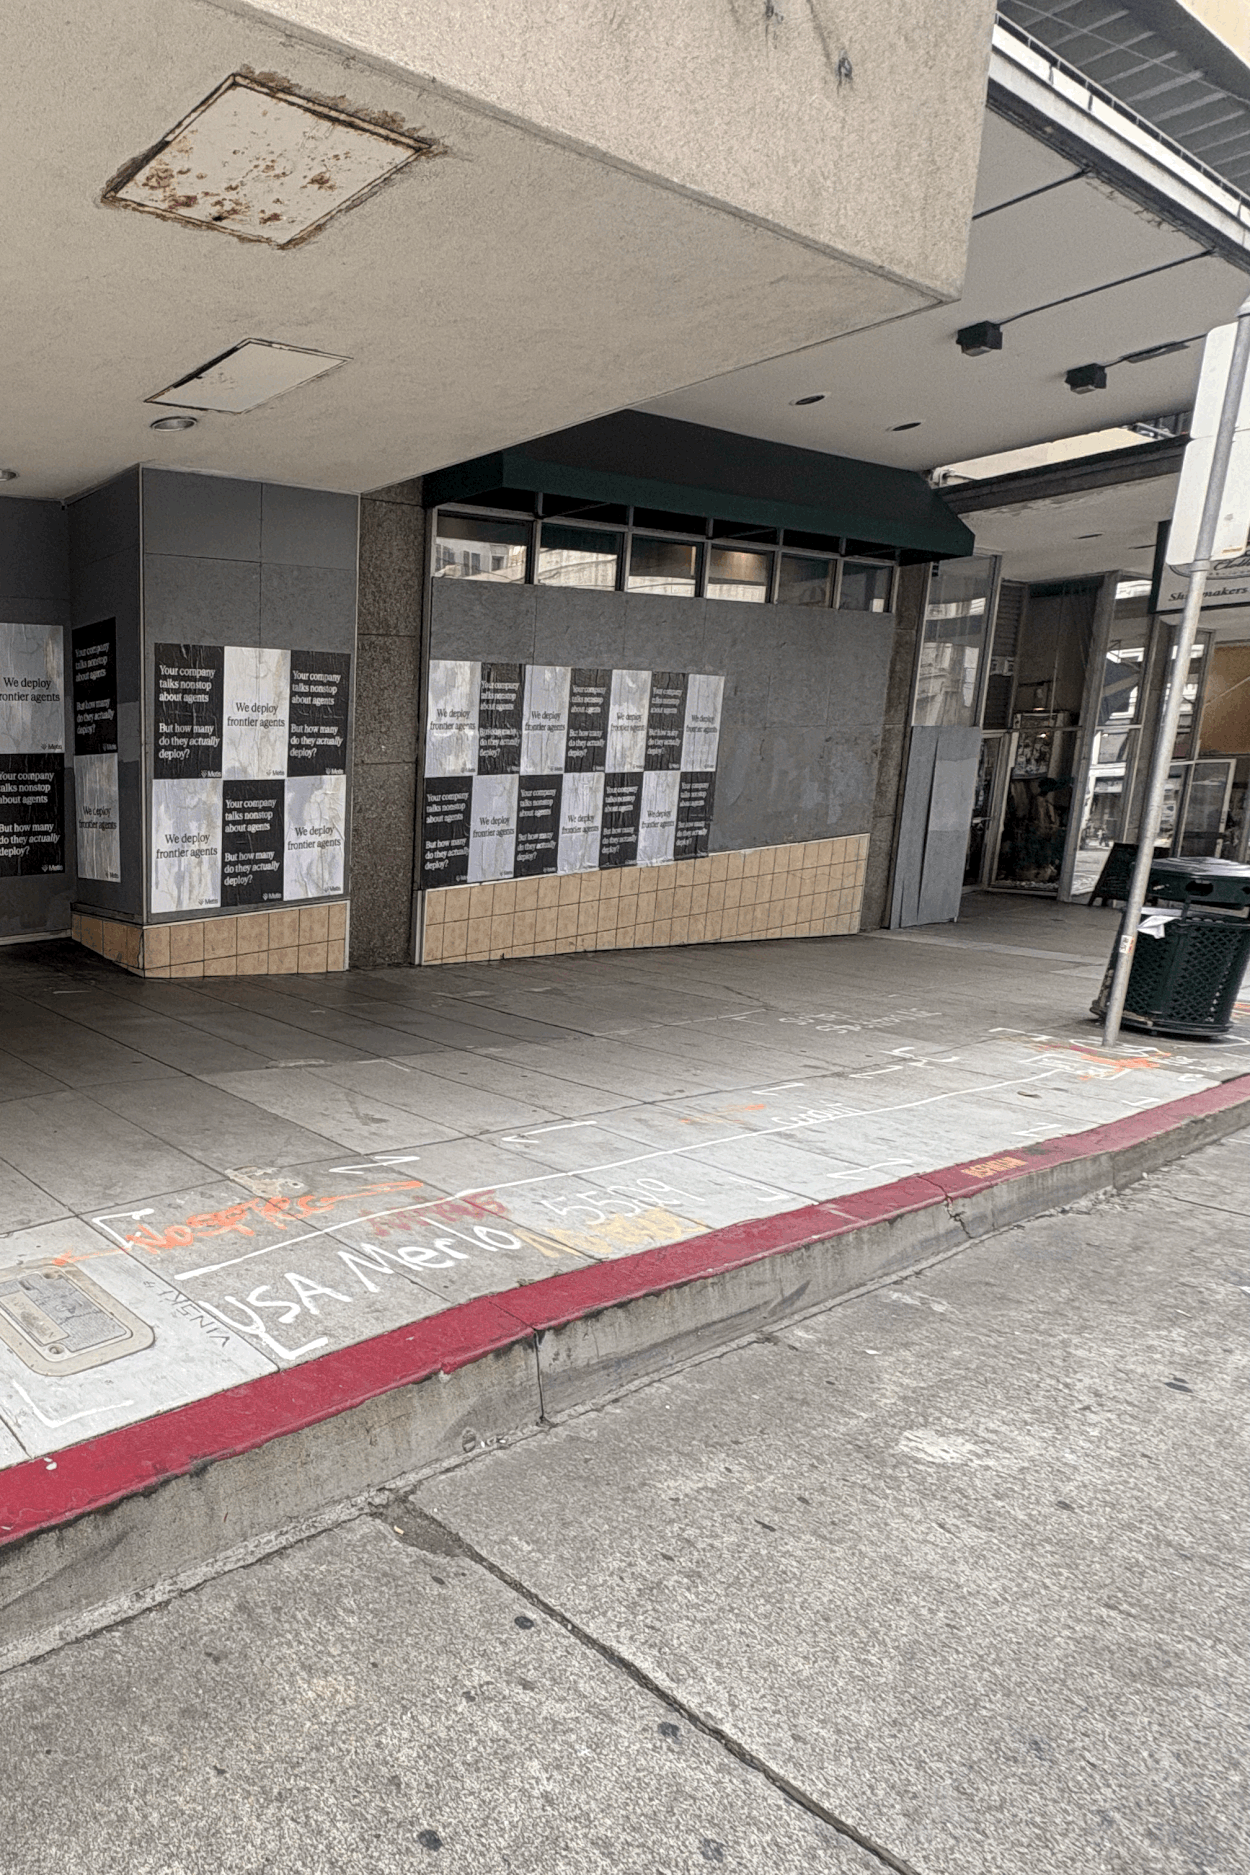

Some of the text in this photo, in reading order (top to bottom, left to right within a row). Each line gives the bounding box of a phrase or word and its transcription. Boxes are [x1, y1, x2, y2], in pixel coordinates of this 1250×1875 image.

[1168, 587, 1249, 601] Shmakers
[159, 664, 215, 678] Your company
[2, 677, 51, 690] We deploy
[159, 678, 211, 691] talks nonstop
[30, 693, 59, 703] agents
[159, 691, 208, 703] about agents
[235, 702, 278, 715] We deploy
[227, 716, 285, 728] frontier agents
[159, 723, 214, 734] But how many
[158, 735, 219, 747] do they actually
[158, 748, 190, 760] deploy?
[17, 772, 54, 781] company
[18, 784, 50, 793] nonstop
[22, 795, 48, 805] agents
[225, 799, 276, 808] Your company
[225, 811, 273, 820] talks nonstop
[13, 823, 31, 832] how
[32, 823, 54, 832] many
[224, 822, 270, 833] about agents
[294, 825, 334, 836] We deploy
[10, 834, 28, 845] they
[28, 833, 60, 843] actually
[164, 832, 210, 844] We deploy
[287, 838, 340, 850] frontier agents
[156, 847, 217, 858] frontier agents
[224, 851, 275, 861] But how many
[224, 860, 280, 873] do they actually
[224, 874, 252, 886] deploy?
[197, 1272, 352, 1334] USA
[338, 1217, 522, 1292] Merlo
